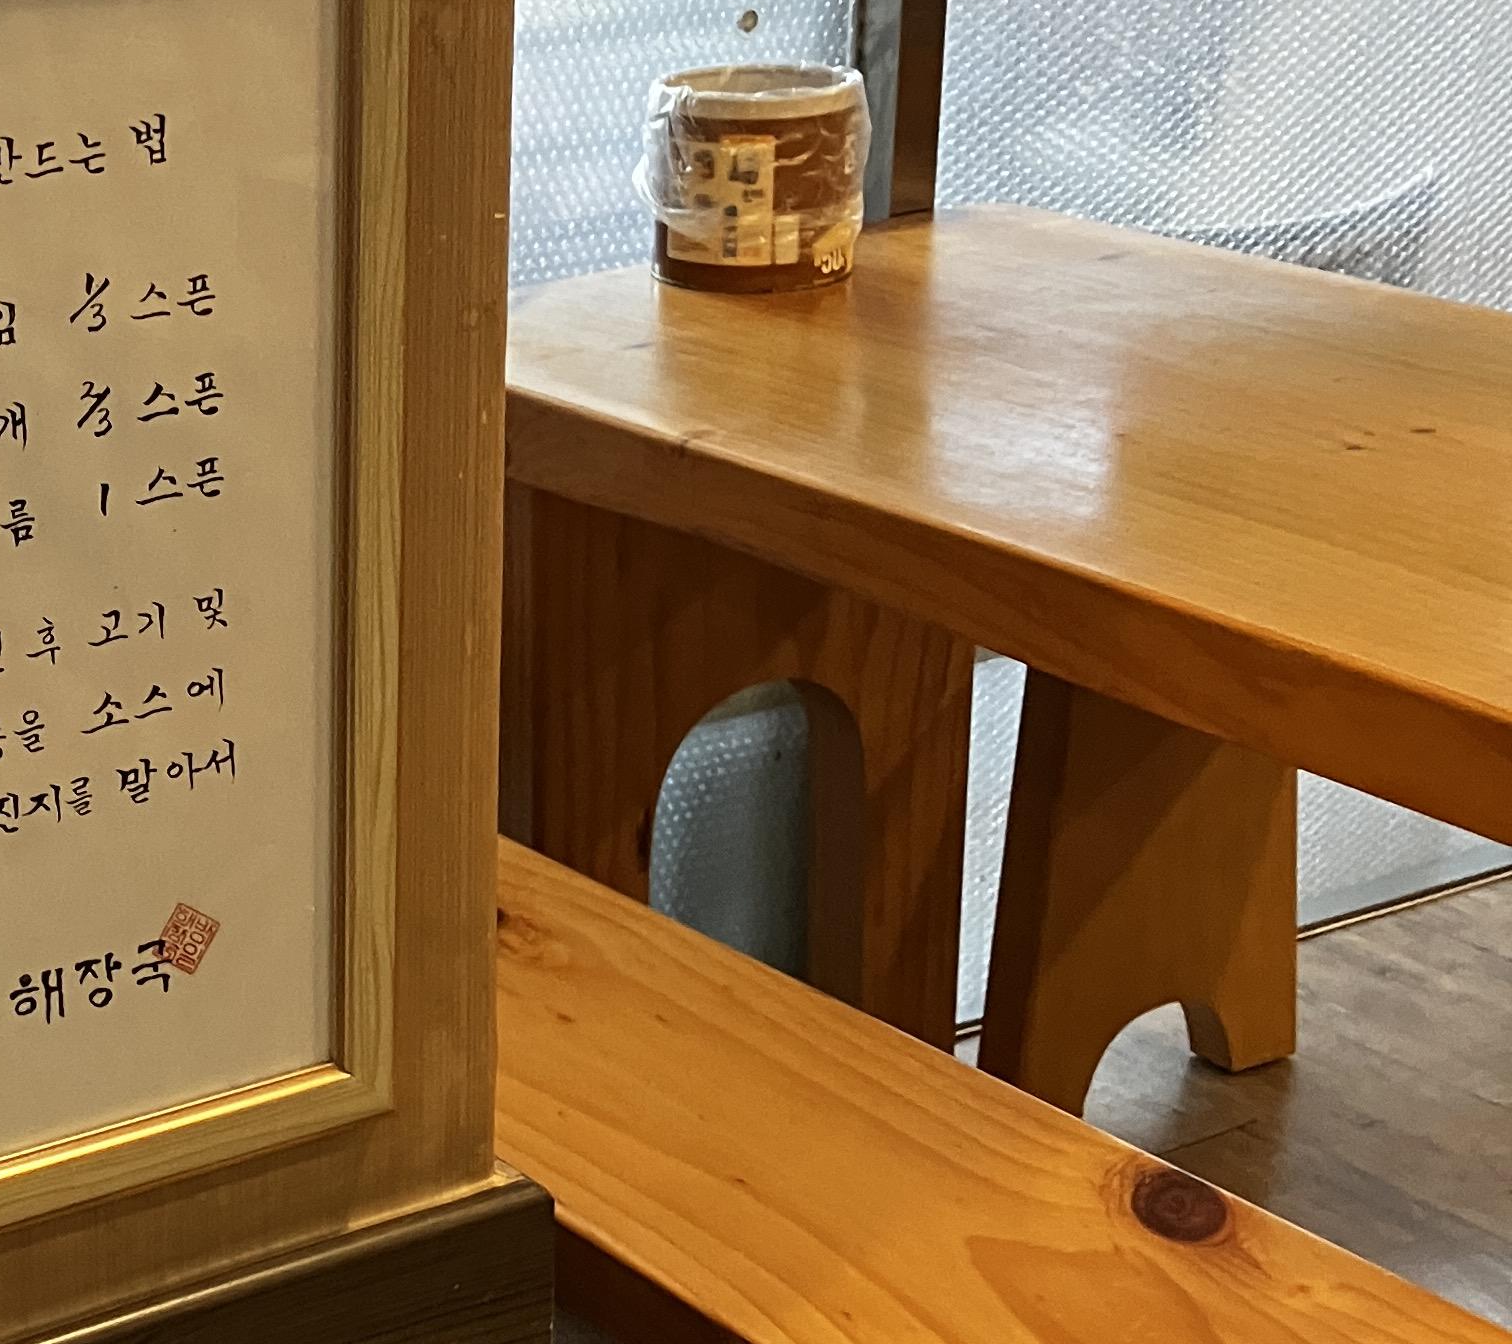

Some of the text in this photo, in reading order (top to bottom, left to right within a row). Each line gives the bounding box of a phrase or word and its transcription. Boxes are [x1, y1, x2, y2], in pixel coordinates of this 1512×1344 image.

[129, 114, 166, 165] 법
[131, 274, 215, 319] 스픈
[137, 373, 223, 421] 스픈
[101, 483, 109, 516] 1
[136, 457, 224, 505] 스픈
[88, 602, 164, 646] 고기
[193, 588, 227, 629] 및
[81, 668, 223, 734] 소스에
[116, 739, 235, 803] 말아서
